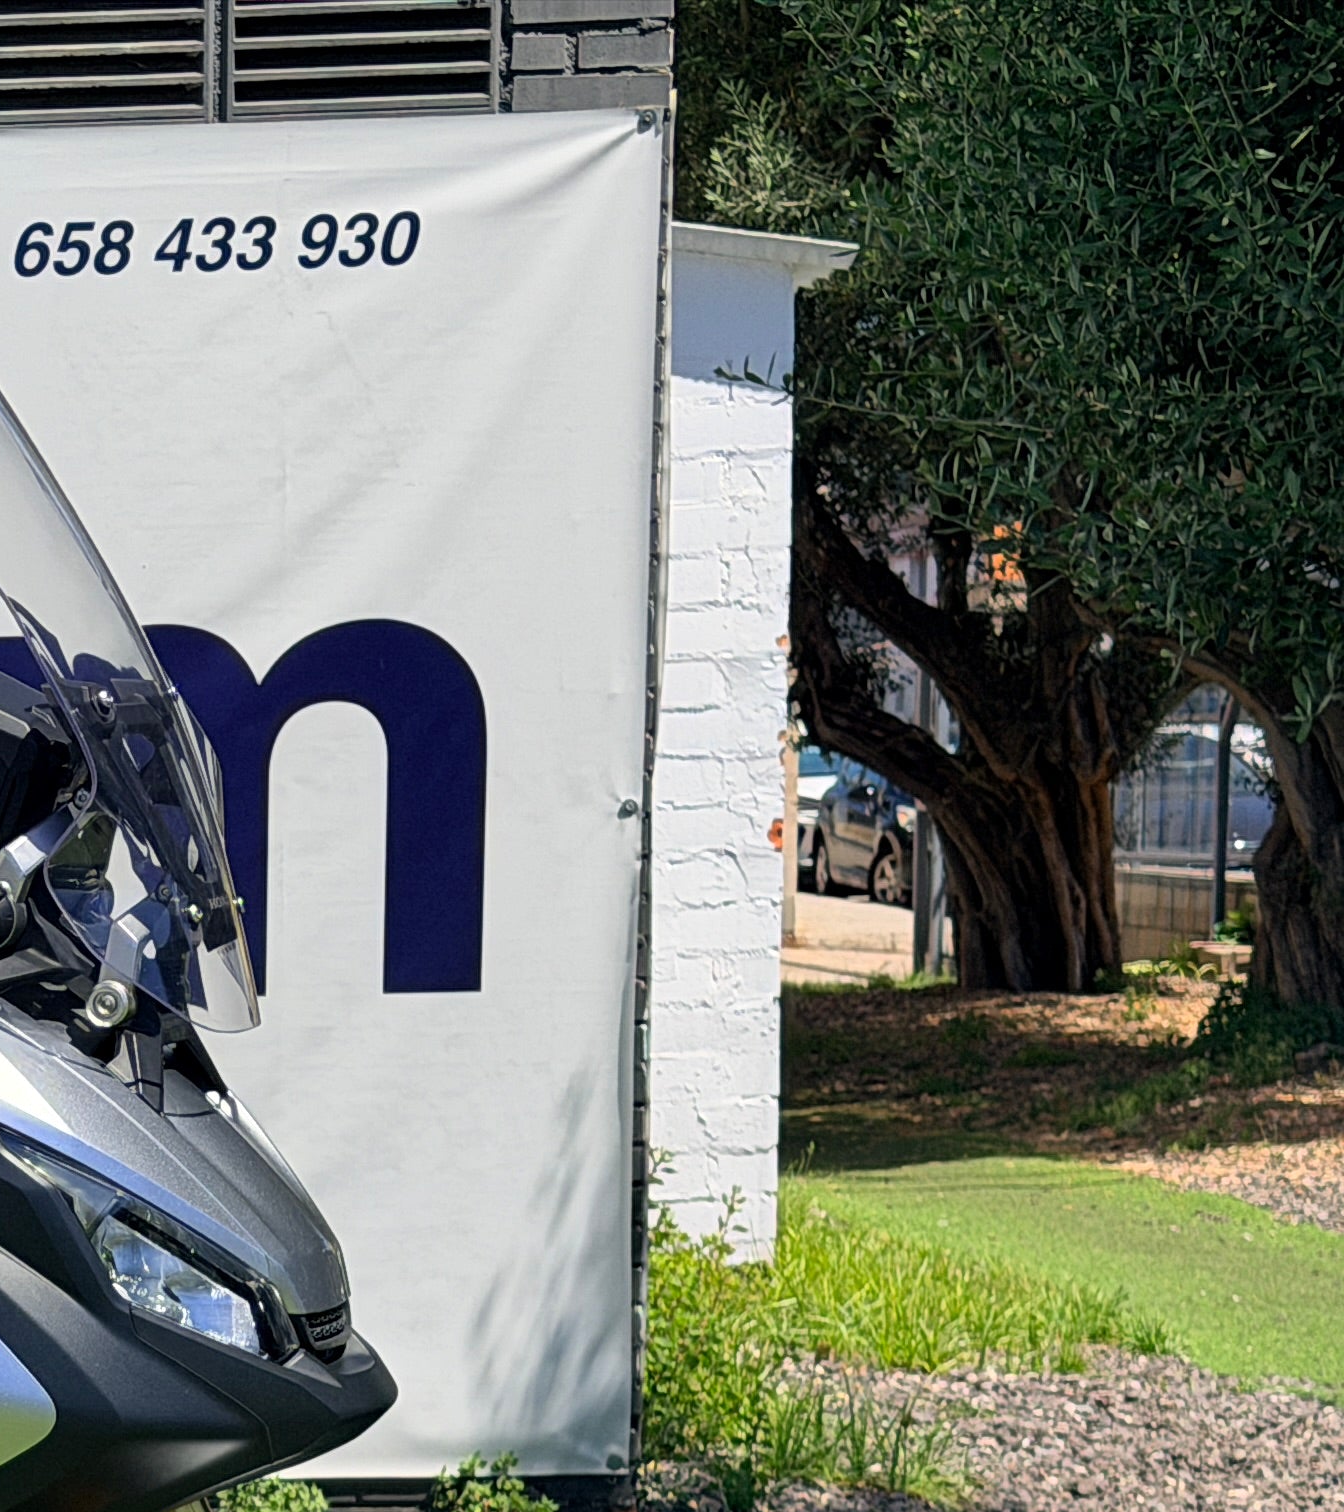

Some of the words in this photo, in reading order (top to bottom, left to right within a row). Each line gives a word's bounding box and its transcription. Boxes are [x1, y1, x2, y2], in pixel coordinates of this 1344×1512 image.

[14, 220, 134, 278] 658
[154, 215, 277, 273] 433
[297, 210, 421, 270] 930
